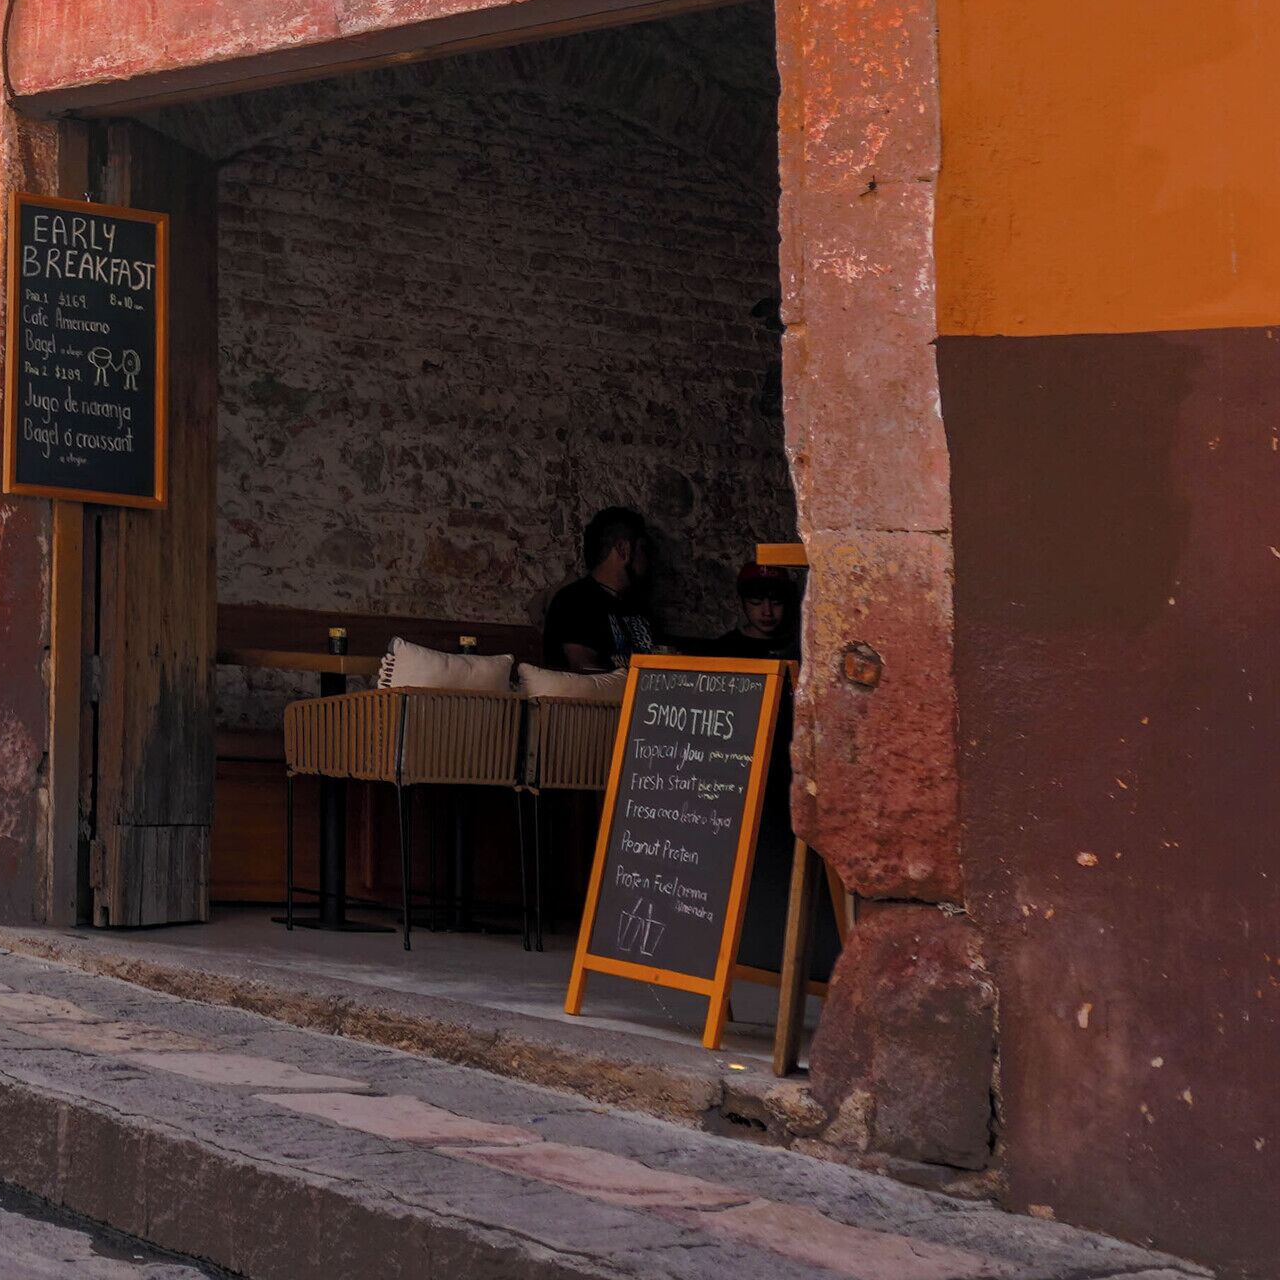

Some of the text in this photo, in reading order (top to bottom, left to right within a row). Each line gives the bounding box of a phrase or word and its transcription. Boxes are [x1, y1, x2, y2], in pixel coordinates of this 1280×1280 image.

[34, 215, 116, 253] EARLY
[23, 245, 156, 291] BREAKFAST
[55, 307, 111, 334] Americano
[24, 328, 56, 360] Bagel
[24, 382, 132, 429] Jugo de naranja
[24, 417, 59, 458] Bagel
[76, 427, 134, 452] croissant
[640, 673, 669, 691] OPEN
[643, 703, 734, 740] SMOOTHIES
[634, 739, 678, 768] Tropical
[676, 742, 704, 770] glow
[630, 773, 663, 791] Fresh
[668, 774, 698, 791] Start
[626, 799, 656, 819] Fresa
[657, 808, 679, 820] coco
[621, 829, 699, 865] Peanut Protein
[653, 874, 679, 896] Fuel
